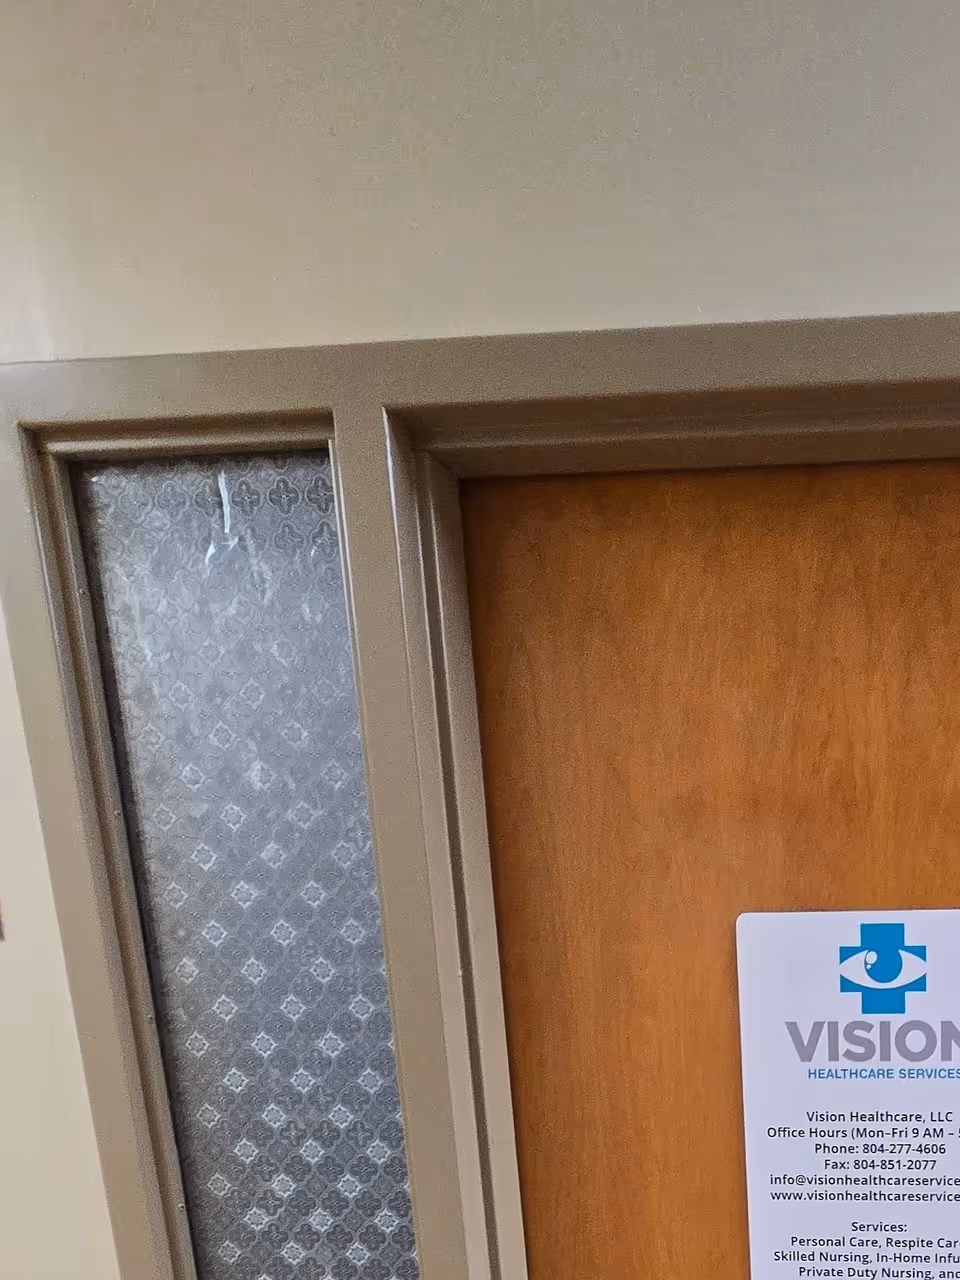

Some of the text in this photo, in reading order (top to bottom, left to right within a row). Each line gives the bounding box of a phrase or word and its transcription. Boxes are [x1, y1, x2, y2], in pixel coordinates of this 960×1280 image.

[808, 1068, 894, 1079] HEALTHCARE
[807, 1111, 953, 1124] Vision Healthcare, LLC
[767, 1127, 804, 1138] Office
[809, 1128, 847, 1138] Hours
[912, 1128, 919, 1138] 9
[923, 1128, 943, 1138] AM
[815, 1143, 946, 1154] Phone: 804-277-4606
[825, 1160, 936, 1170] Fax: 804-851-2077
[851, 1222, 907, 1232] Services:
[791, 1237, 845, 1247] Personal
[850, 1237, 881, 1249] Care,
[886, 1238, 933, 1250] Respite
[774, 1252, 815, 1262] Skilled
[820, 1252, 872, 1265] Nursing,
[876, 1253, 930, 1263] In-Home
[799, 1267, 843, 1278] Private
[848, 1268, 877, 1280] Duty
[882, 1268, 935, 1280] Nursing,
